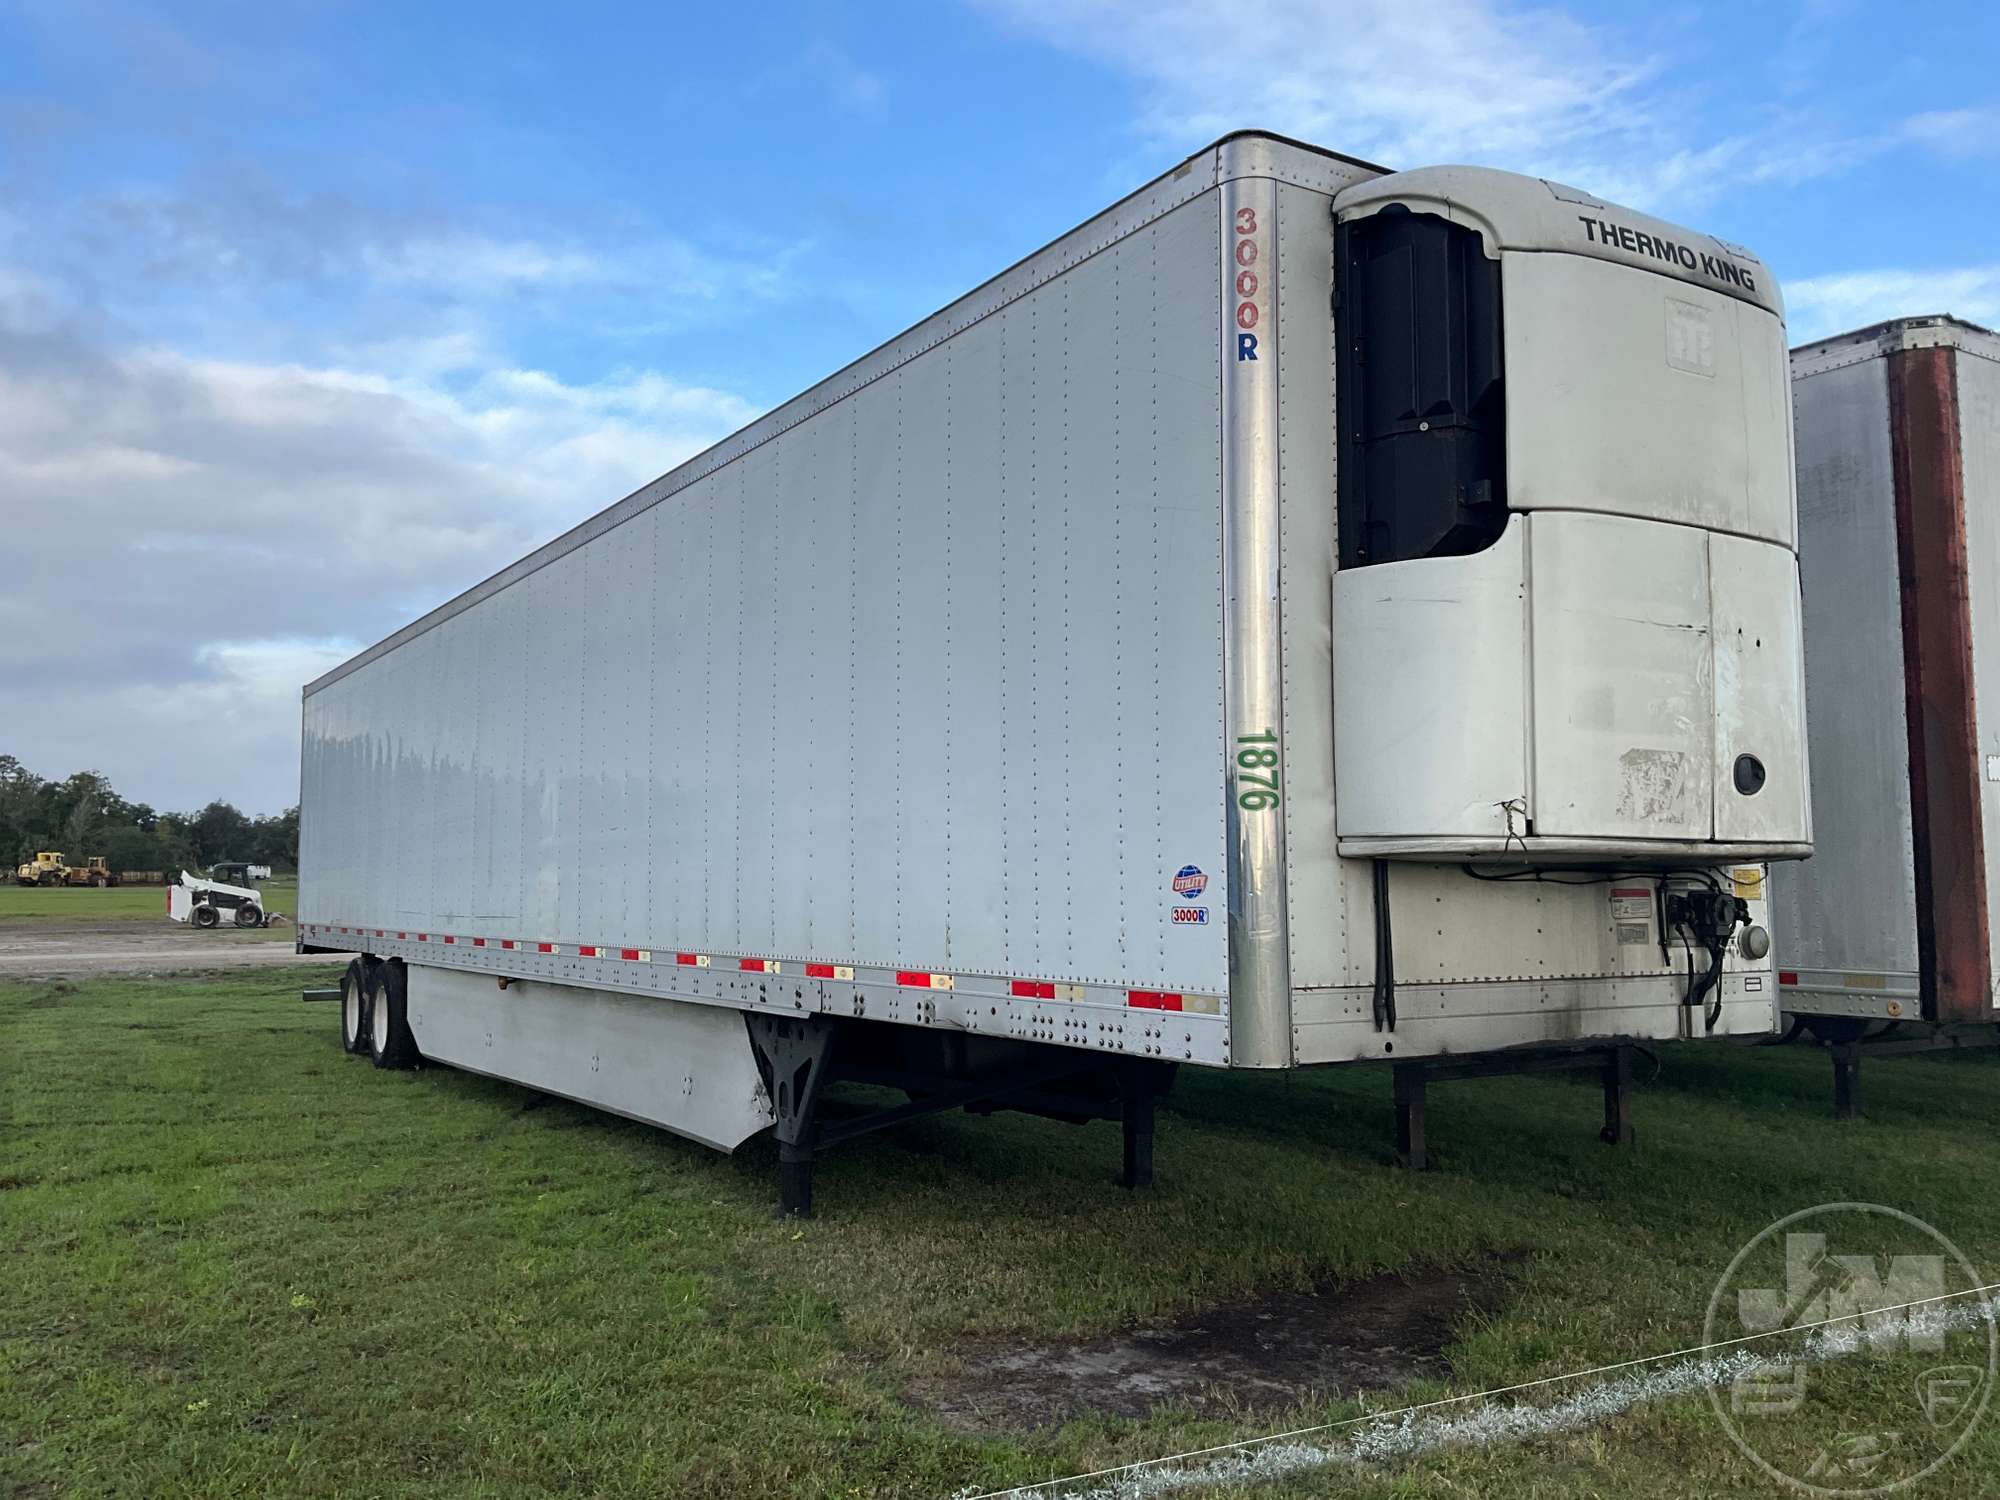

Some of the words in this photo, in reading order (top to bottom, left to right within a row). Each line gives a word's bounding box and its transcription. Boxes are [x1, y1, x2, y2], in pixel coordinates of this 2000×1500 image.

[1578, 215, 1697, 270] THERMO
[1699, 252, 1756, 292] KING
[1237, 728, 1280, 811] 1876
[1174, 876, 1207, 891] UTILITY
[1173, 909, 1205, 922] 3000R
